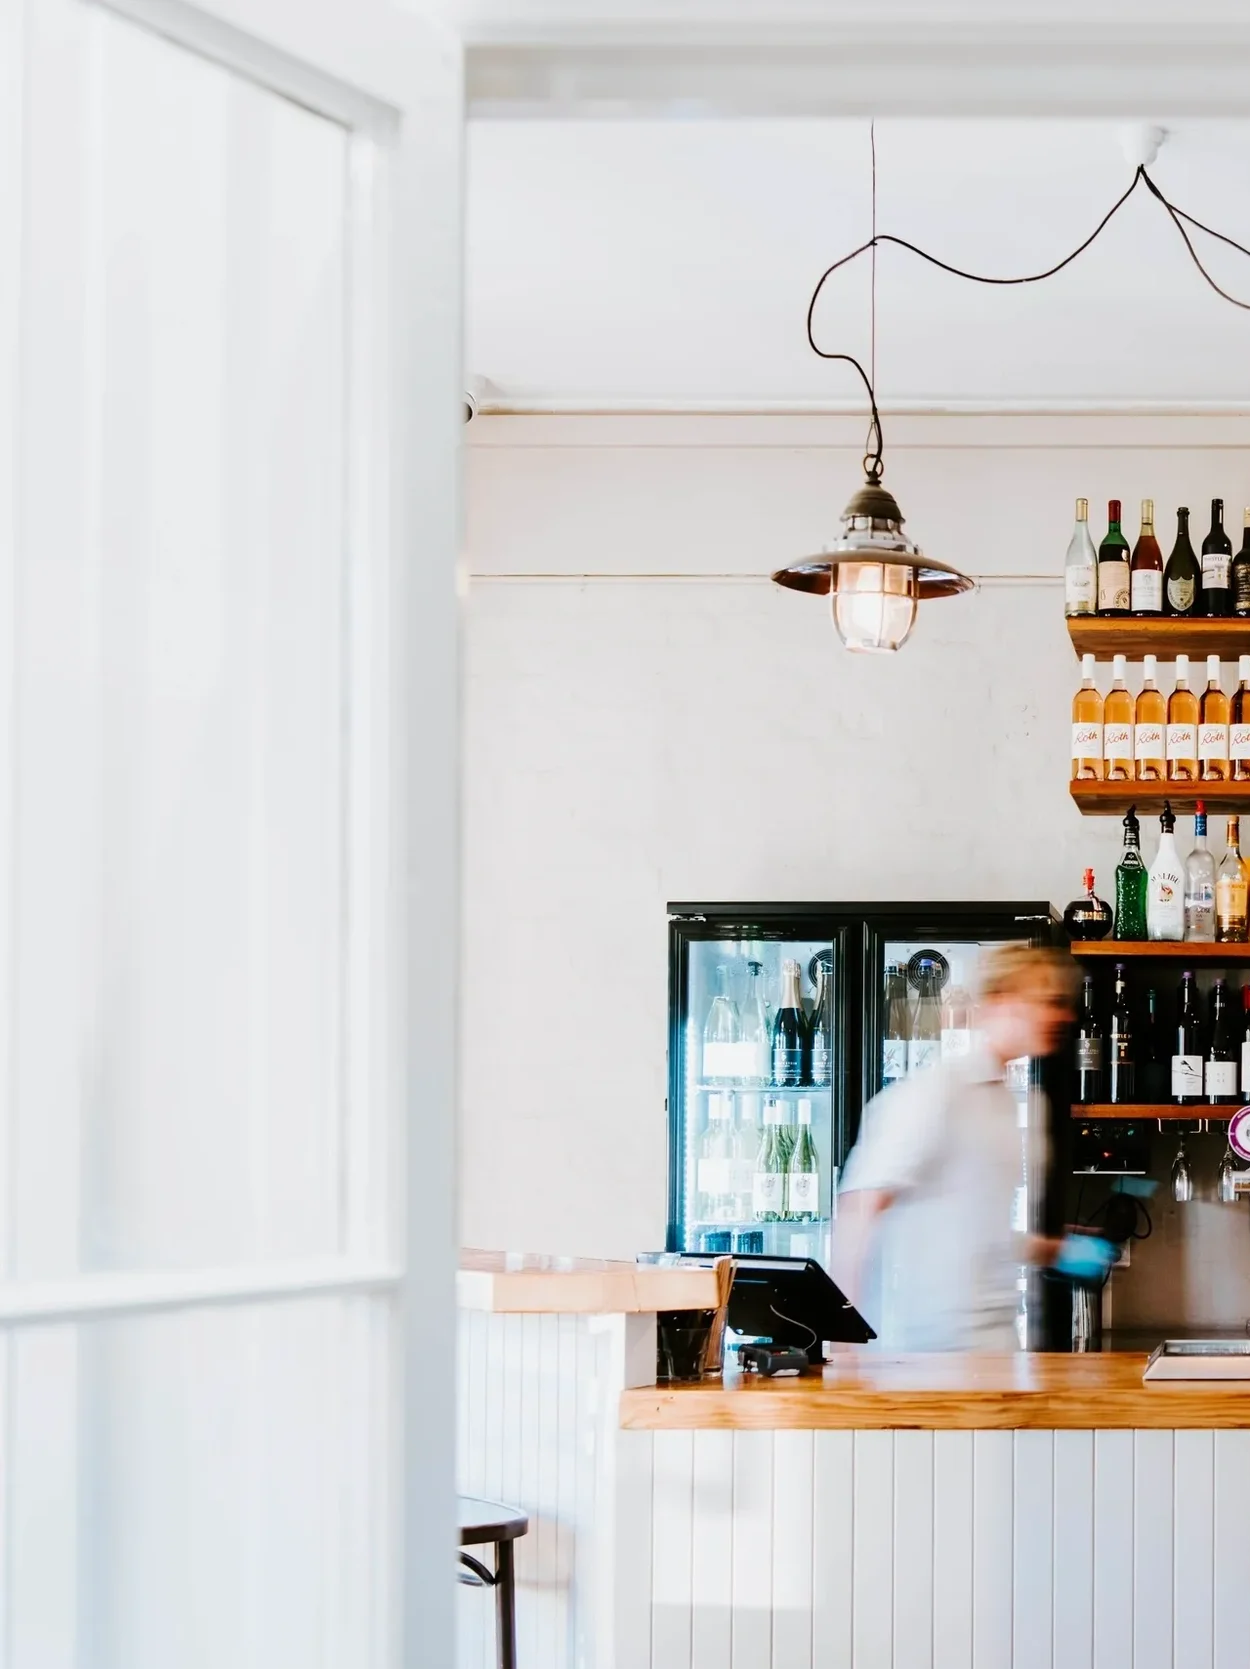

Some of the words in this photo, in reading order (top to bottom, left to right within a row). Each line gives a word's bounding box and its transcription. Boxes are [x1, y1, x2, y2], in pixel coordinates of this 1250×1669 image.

[1074, 732, 1097, 745] Roth
[1106, 732, 1128, 745] Roth
[1136, 732, 1160, 745] Roth
[1168, 732, 1191, 745] Roth
[1201, 732, 1224, 745] Roth
